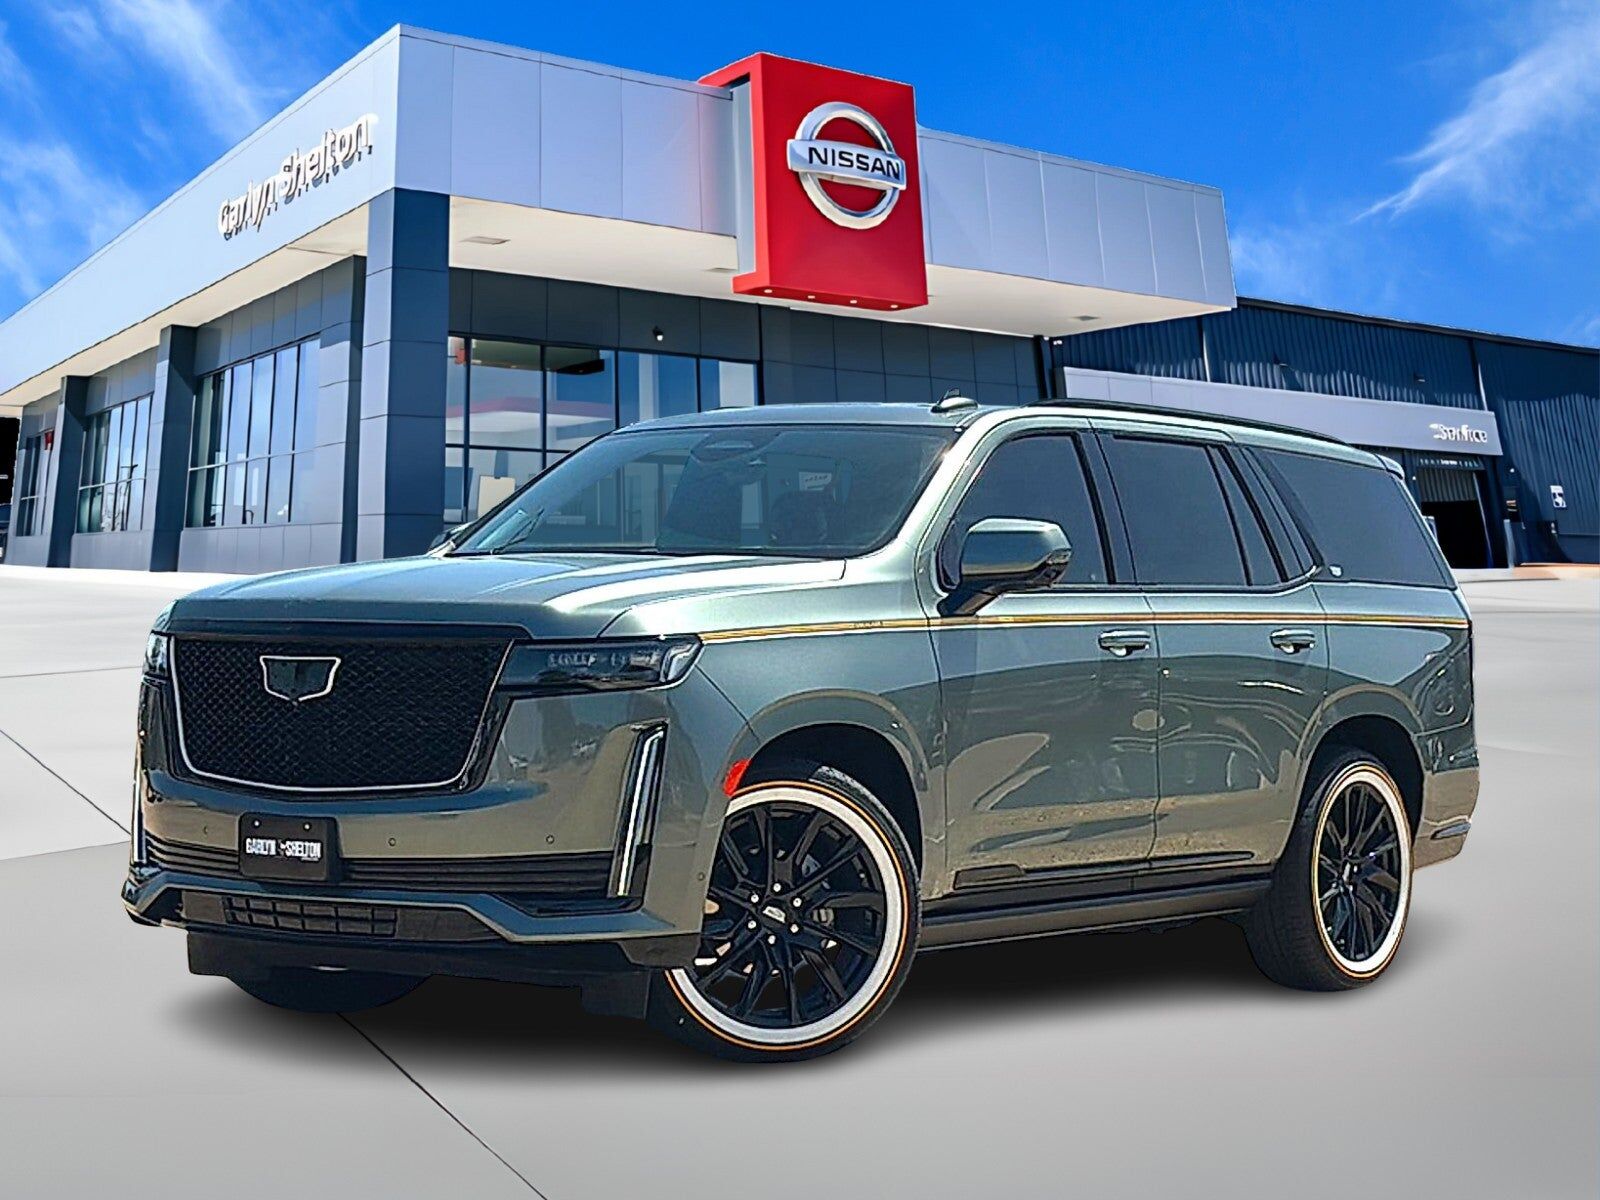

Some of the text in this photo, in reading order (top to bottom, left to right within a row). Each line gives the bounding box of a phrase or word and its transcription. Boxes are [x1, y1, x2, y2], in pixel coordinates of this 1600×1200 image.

[279, 114, 375, 204] Shelton
[808, 146, 900, 180] NISSAN
[1429, 423, 1488, 443] Service
